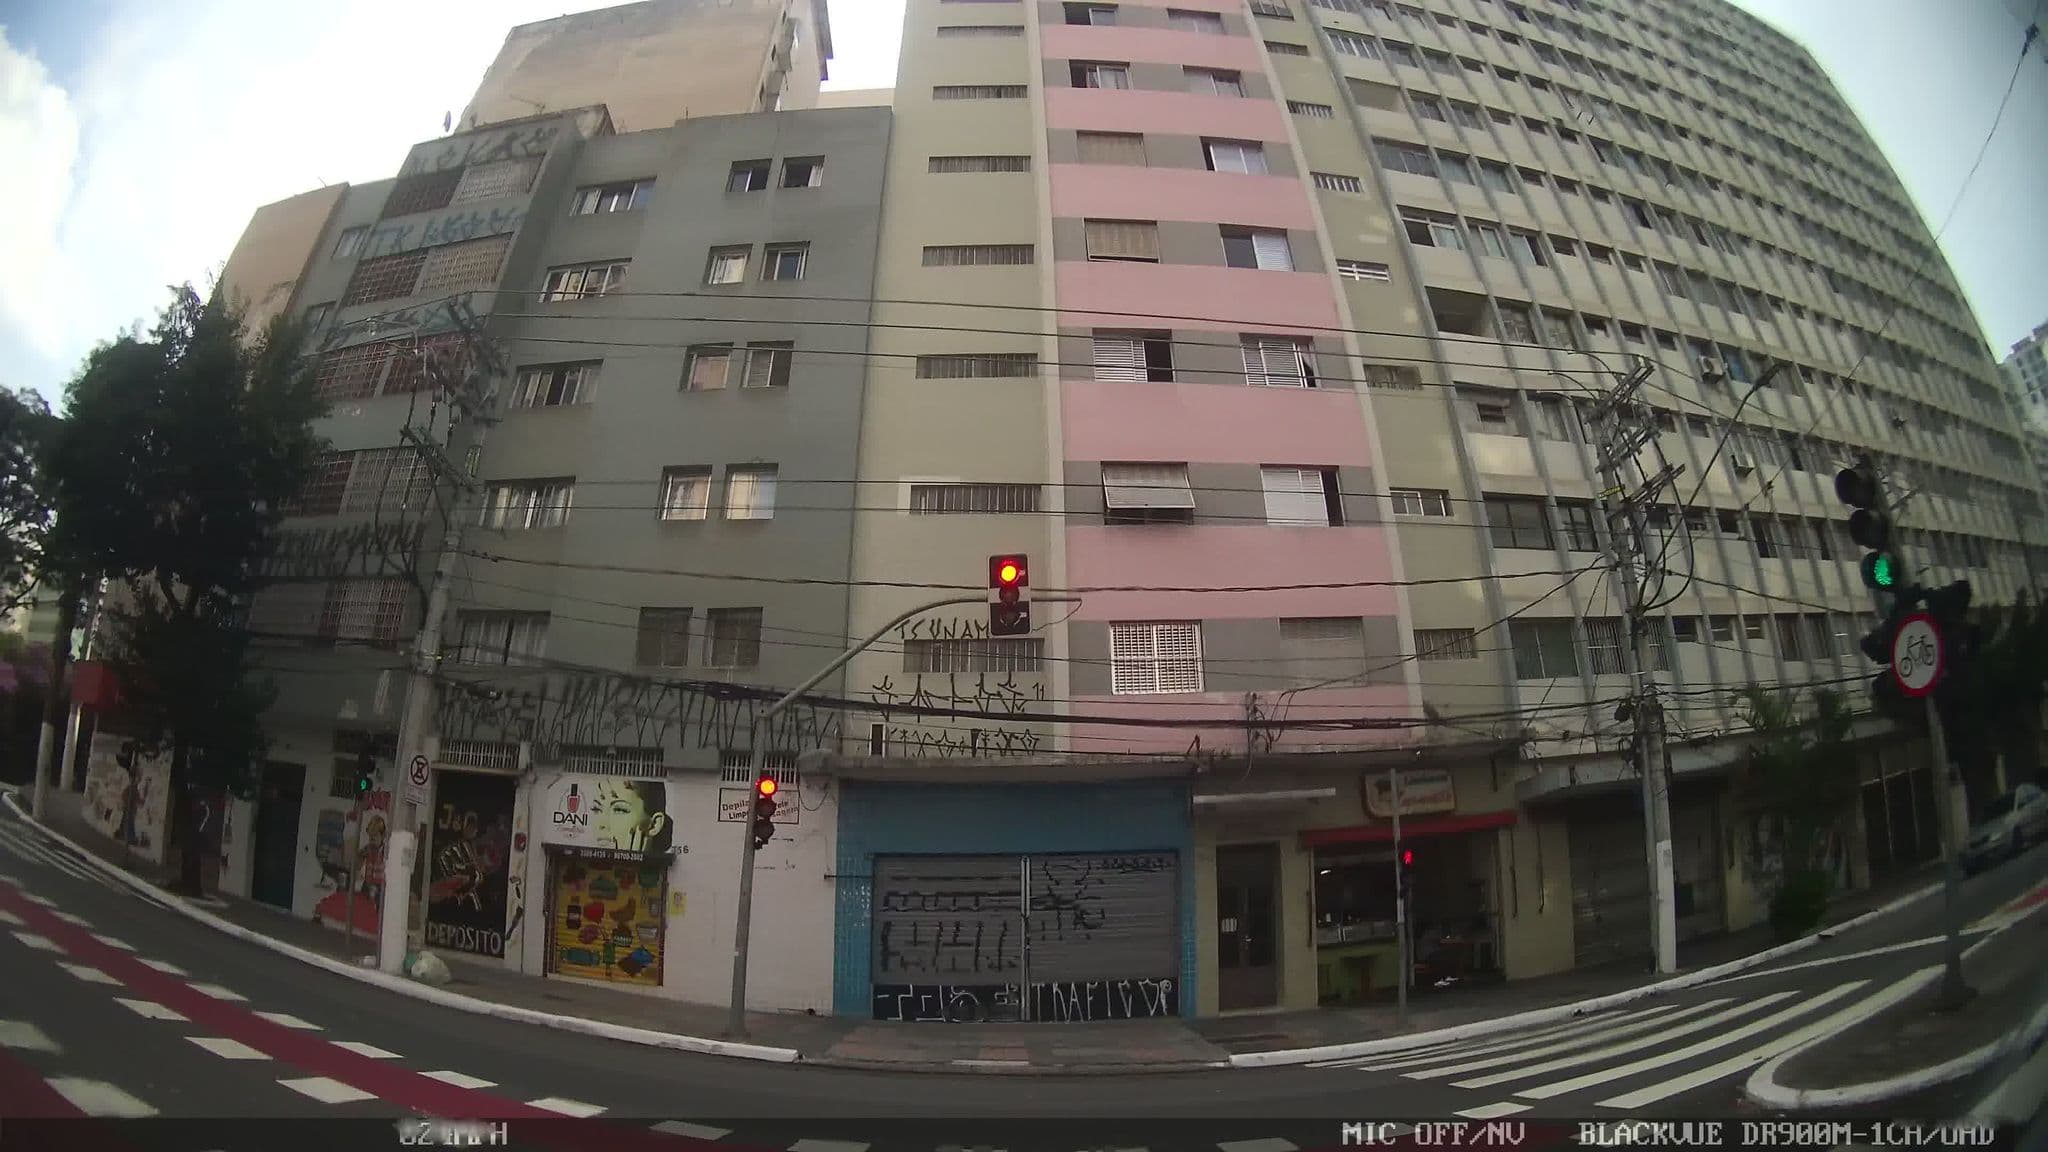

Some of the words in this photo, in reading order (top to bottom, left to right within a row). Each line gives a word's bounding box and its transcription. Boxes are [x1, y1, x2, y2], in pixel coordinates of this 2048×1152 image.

[895, 617, 989, 640] TSUNAM
[722, 800, 750, 811] Depil
[553, 811, 588, 826] DANI
[729, 811, 749, 819] Limp
